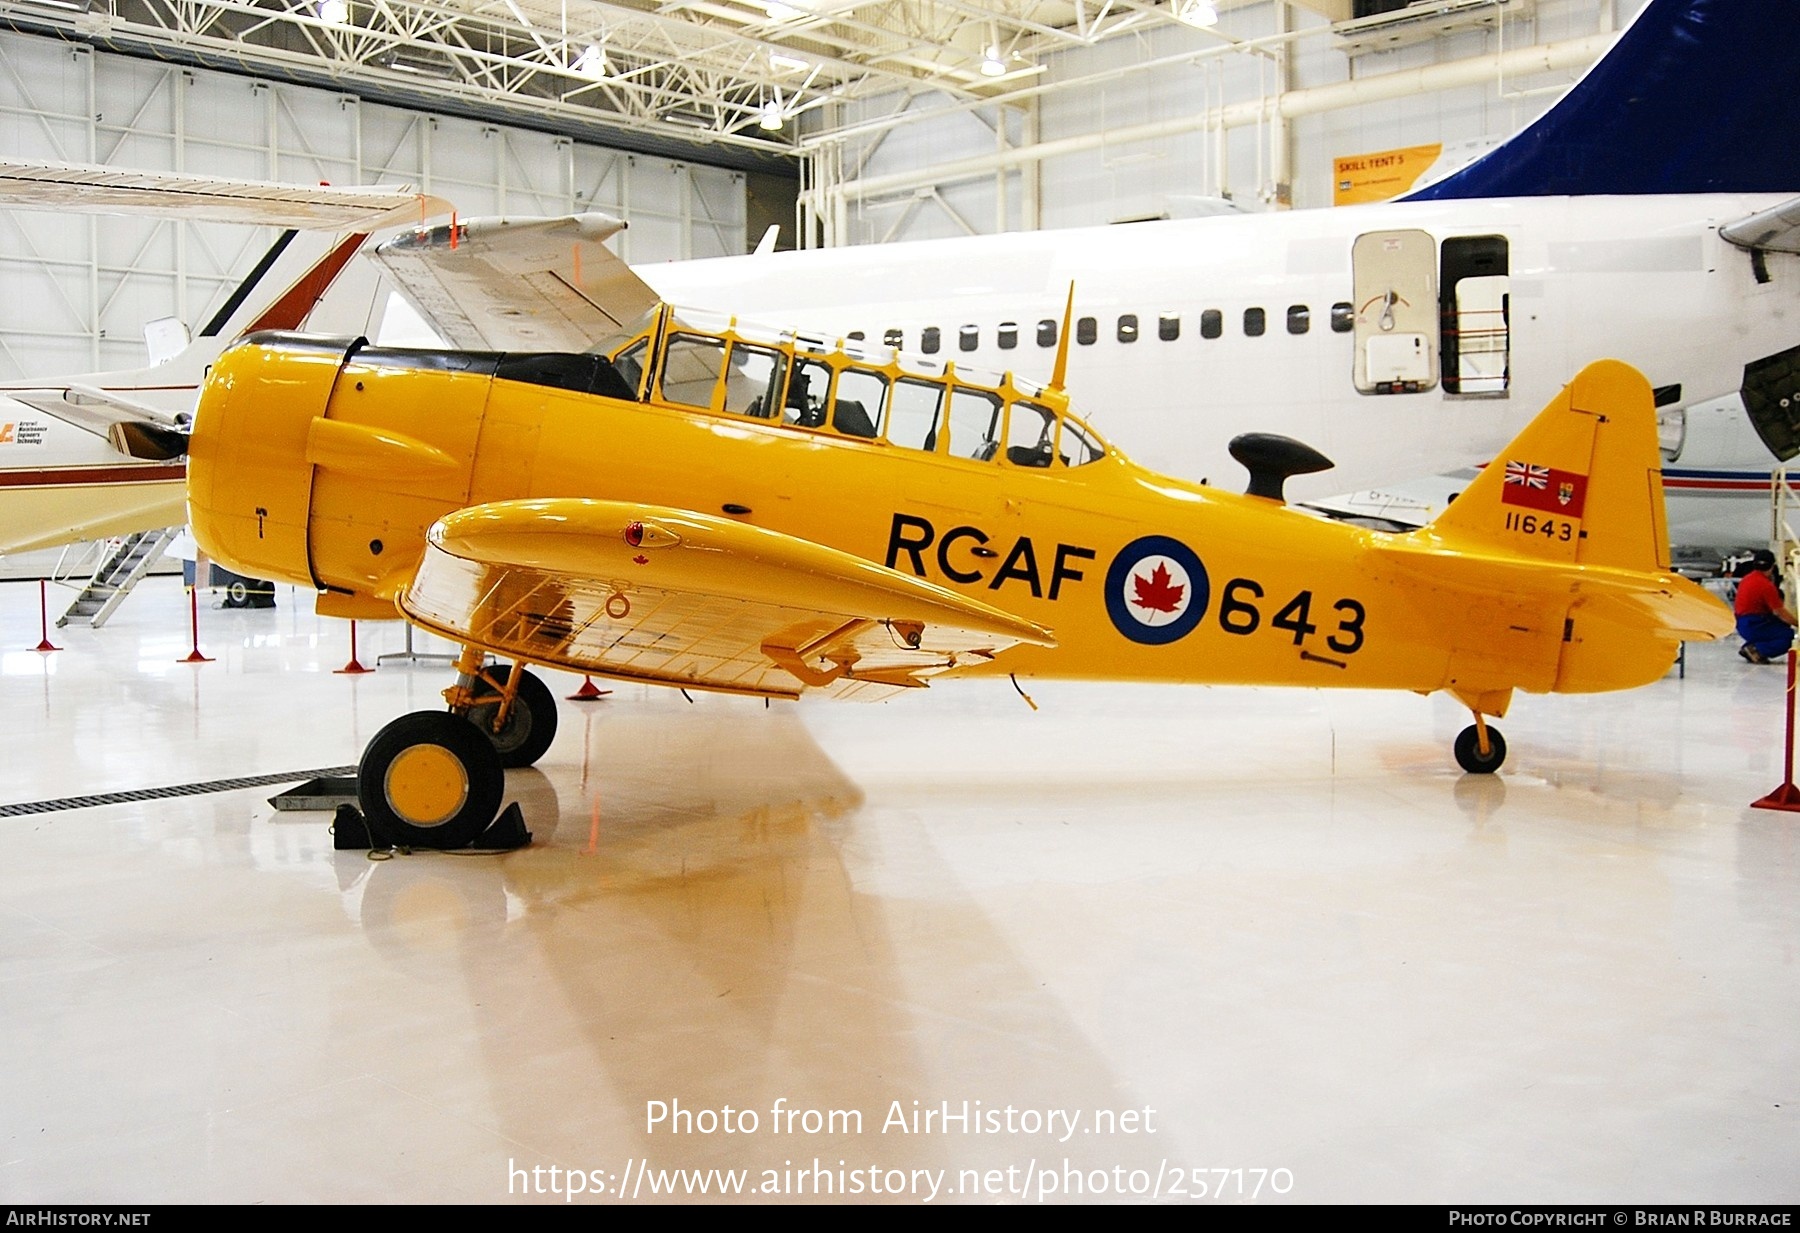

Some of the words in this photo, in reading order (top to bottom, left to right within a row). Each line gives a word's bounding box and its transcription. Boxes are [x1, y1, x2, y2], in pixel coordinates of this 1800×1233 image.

[1339, 161, 1365, 173] SKILL
[1369, 155, 1394, 169] TENT
[1506, 512, 1572, 541] 11643
[885, 513, 1096, 601] RCAF
[1219, 578, 1365, 654] 643
